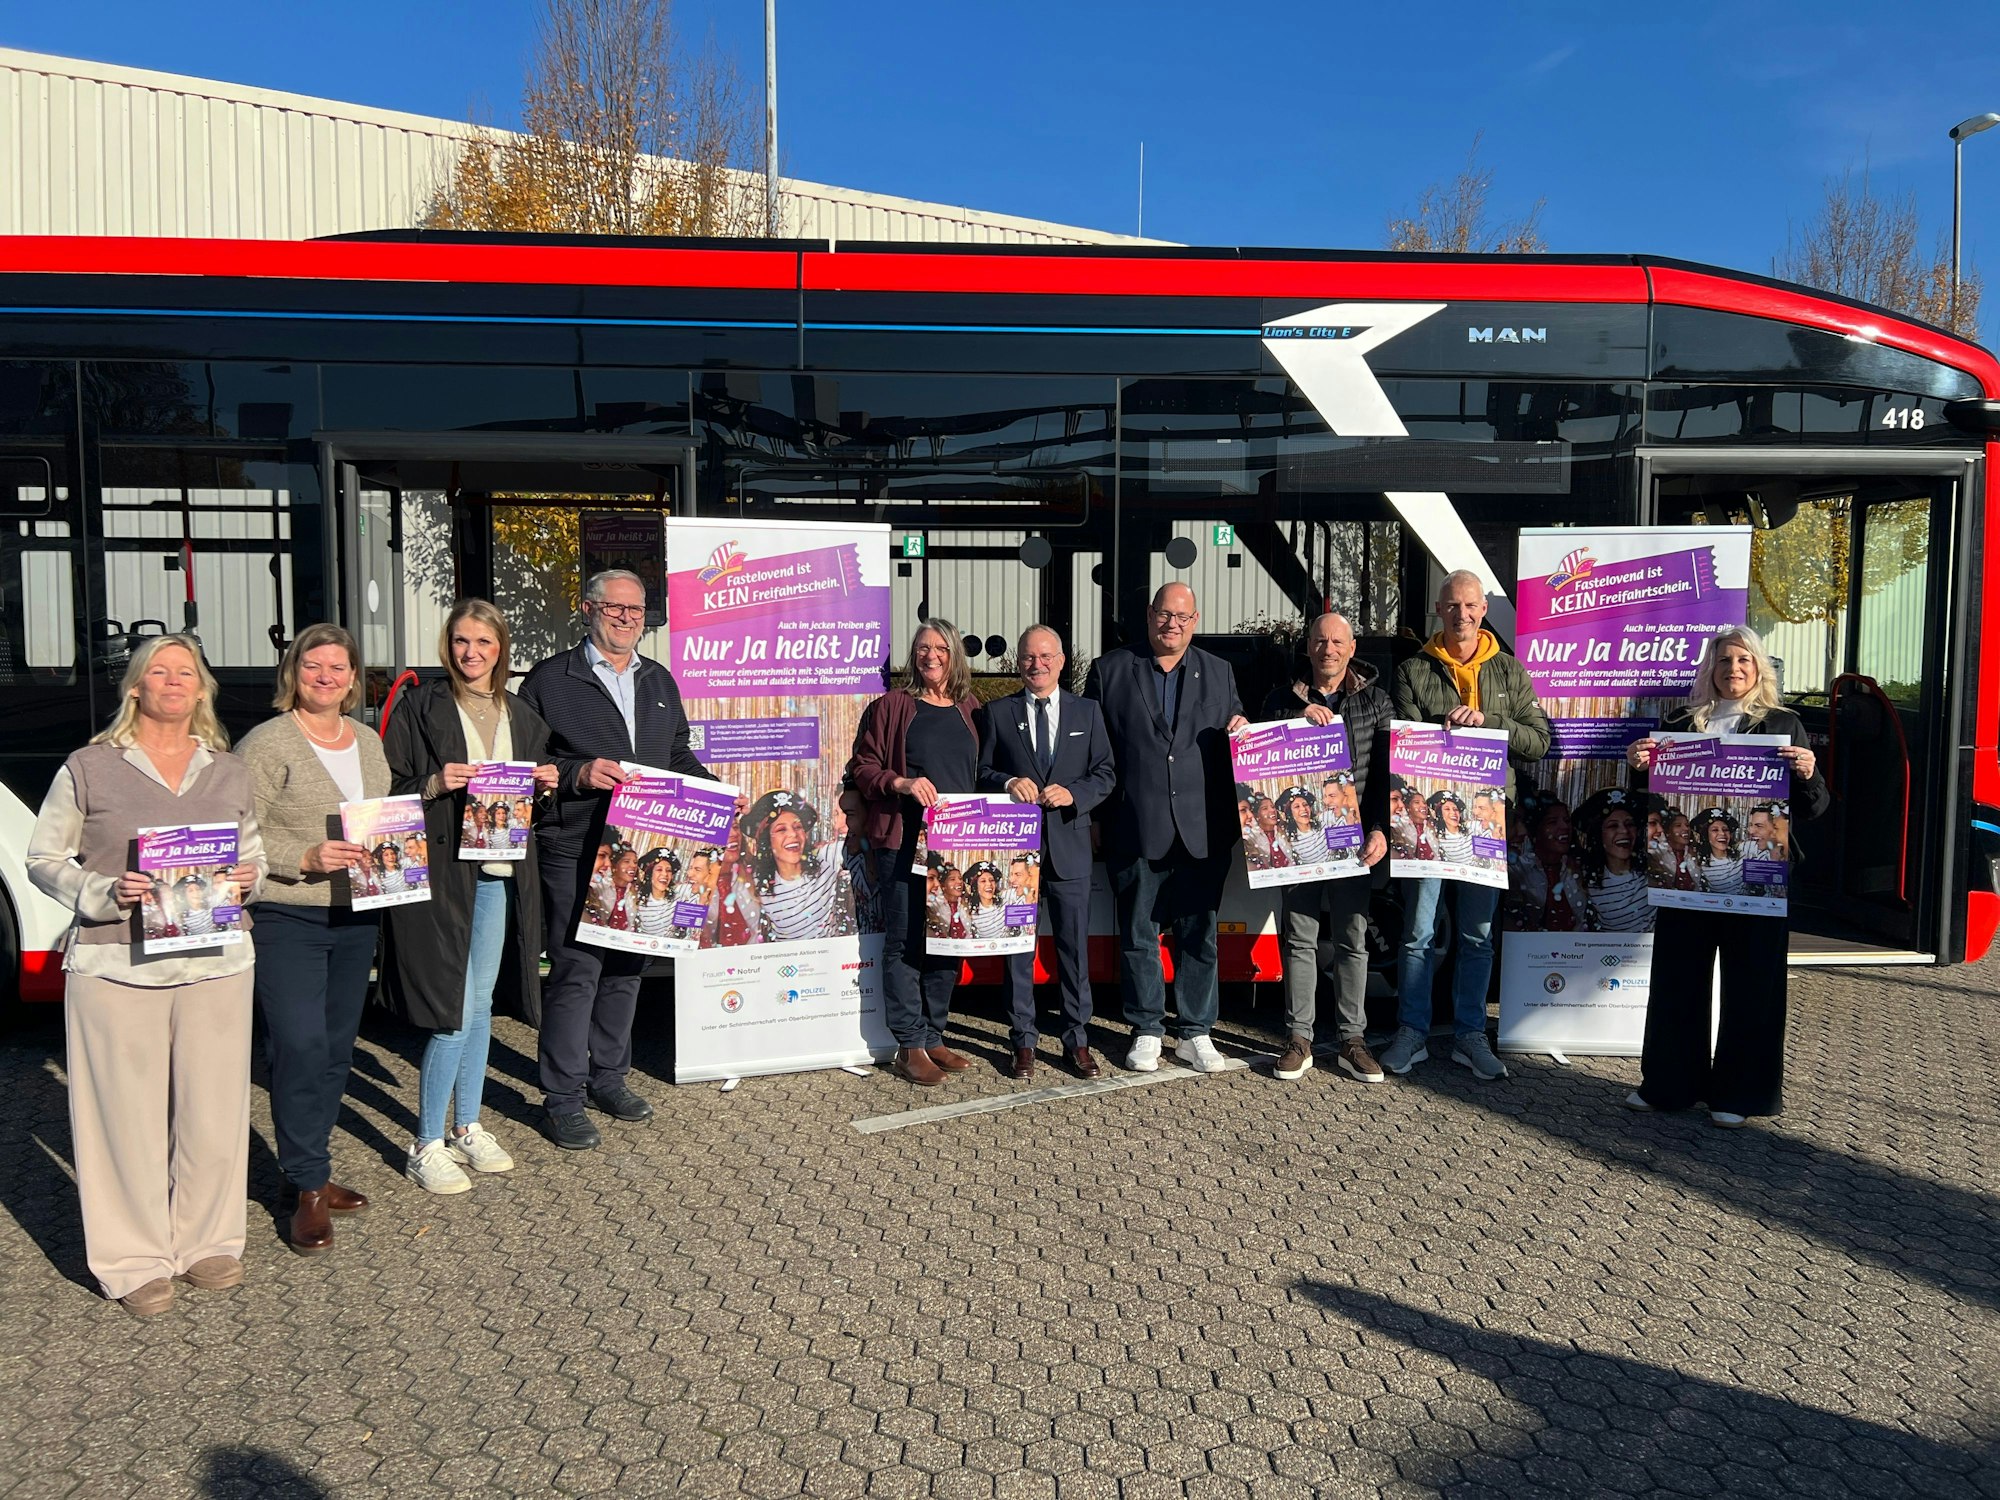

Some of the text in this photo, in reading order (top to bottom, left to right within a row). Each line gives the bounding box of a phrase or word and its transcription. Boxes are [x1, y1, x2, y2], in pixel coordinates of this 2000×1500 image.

[1264, 328, 1351, 338] Lion's City E
[1469, 328, 1546, 343] MAN
[1882, 408, 1924, 430] 418
[586, 532, 658, 542] Nur Ja heißt Ja!
[727, 562, 811, 586] Fastelovend ist
[1575, 566, 1662, 592] Fastelovend ist
[704, 578, 840, 610] KEIN Freifahrtschein.
[1551, 580, 1692, 614] KEIN Freifahrtschein.
[778, 621, 797, 629] Auch
[837, 621, 863, 629] Treiben
[866, 621, 880, 630] gilt:
[1623, 624, 1643, 632] Auch
[1645, 624, 1656, 632] im
[1686, 624, 1715, 632] Treiben
[683, 634, 880, 664] Nur Ja heißt Ja!
[1527, 638, 1577, 663] Nur
[1578, 638, 1611, 666] Ja
[1618, 637, 1689, 662] heißt
[683, 669, 707, 677] Feiert
[709, 669, 735, 677] immer
[737, 668, 797, 677] einvernehmlich
[799, 667, 813, 675] mit
[814, 667, 833, 677] Spaß
[1552, 669, 1577, 677] immer
[1579, 669, 1640, 678] einvernehmlich
[1641, 669, 1656, 677] mit
[1657, 669, 1678, 679] Spaß
[1680, 669, 1696, 677] und
[708, 675, 860, 687] Schaut hin und duldet keine Übergriffe!
[1549, 678, 1577, 687] Schaut
[1579, 678, 1592, 687] hin
[1593, 678, 1609, 687] und
[1611, 678, 1637, 687] duldet
[1639, 678, 1661, 687] keine
[1237, 741, 1343, 766] Nur Ja heißt Ja!
[1394, 747, 1502, 770] Nur Ja heißt Ja!
[1654, 762, 1784, 782] Nur Ja heißt Ja!
[486, 777, 497, 785] Ja
[499, 777, 520, 785] heißt
[520, 778, 533, 786] Ja!
[615, 794, 646, 811] Nur
[644, 800, 665, 815] Ja
[667, 804, 706, 824] heißt
[705, 813, 730, 829] Ja!
[932, 822, 1037, 836] Nur Ja heißt Ja!
[142, 841, 235, 858] Nur Ja heißt Ja!
[841, 957, 874, 970] wupsi
[702, 967, 760, 979] Frauen Notruf
[800, 987, 826, 995] POLIZEI
[841, 989, 864, 997] DESIGN
